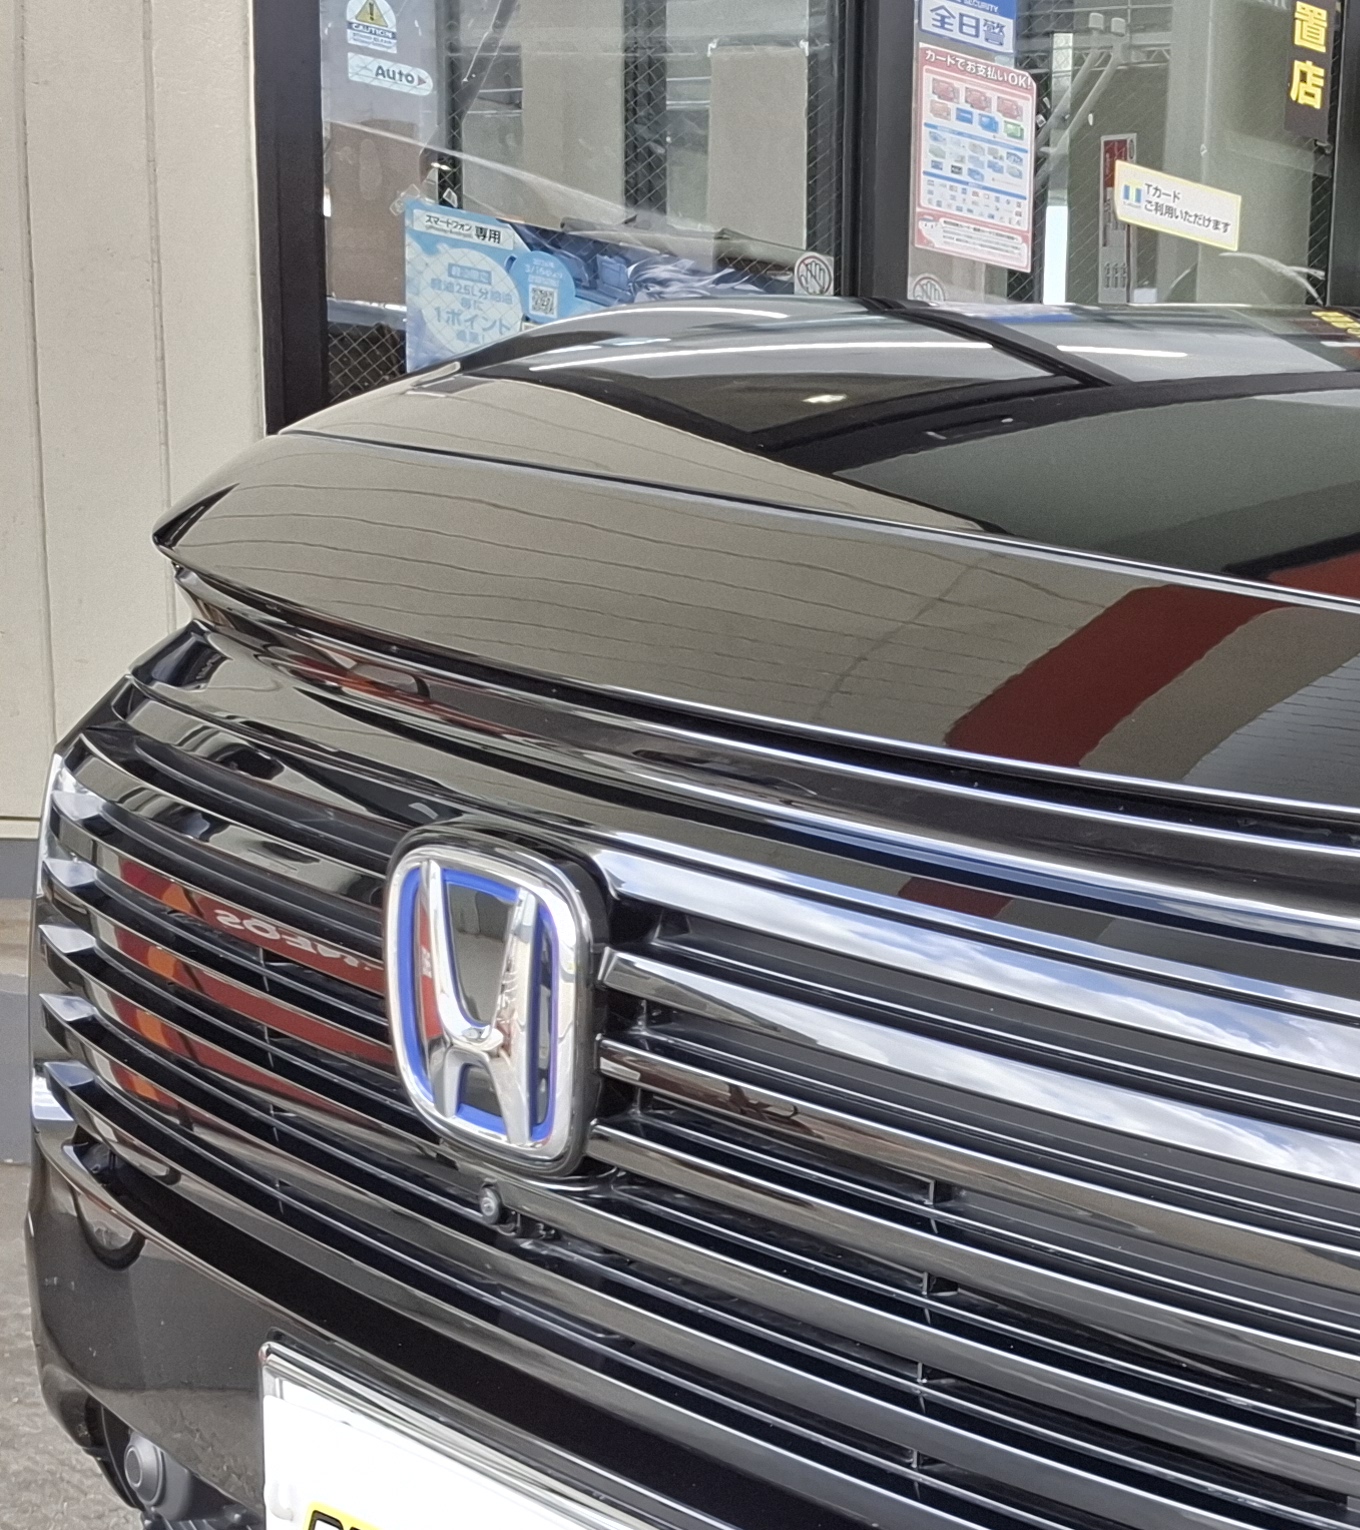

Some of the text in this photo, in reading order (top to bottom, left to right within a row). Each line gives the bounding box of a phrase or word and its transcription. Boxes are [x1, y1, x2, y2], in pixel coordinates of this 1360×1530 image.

[375, 65, 415, 84] Auto
[1144, 199, 1231, 233] ご利用いただけます
